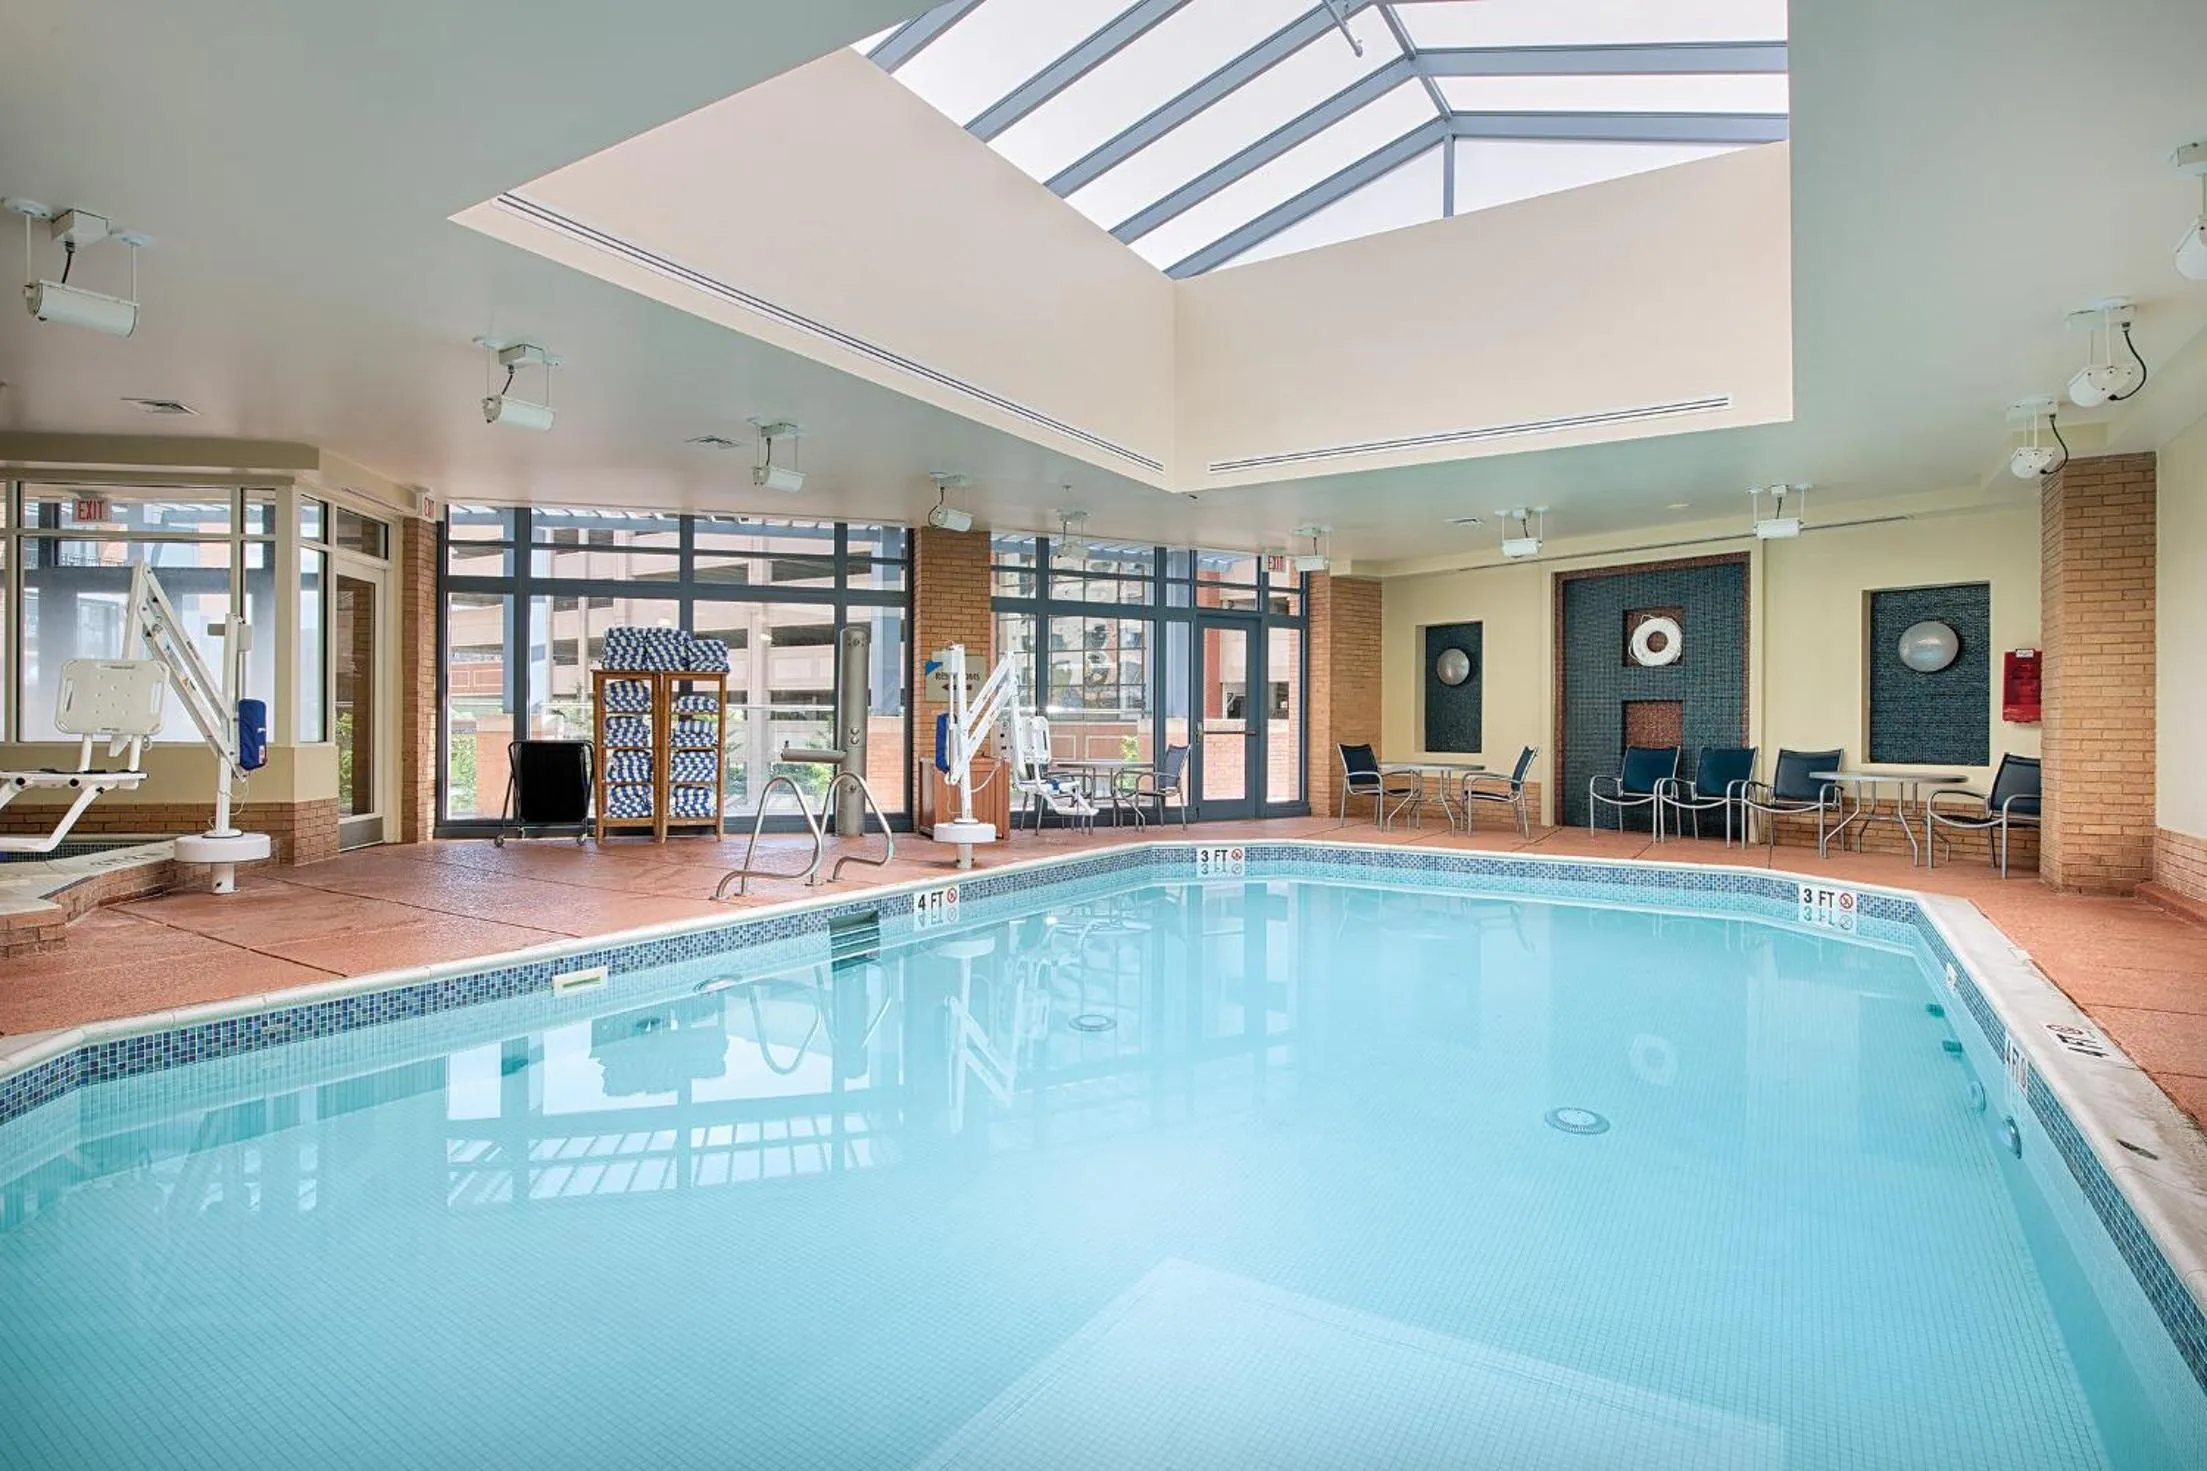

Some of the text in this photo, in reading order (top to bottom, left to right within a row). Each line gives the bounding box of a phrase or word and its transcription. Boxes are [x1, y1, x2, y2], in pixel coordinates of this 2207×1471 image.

[78, 500, 105, 520] EXIT
[1268, 555, 1284, 570] EXIT
[1201, 849, 1228, 863] 3 FT
[917, 890, 944, 911] 4 FT
[1803, 888, 1835, 909] 3 FT
